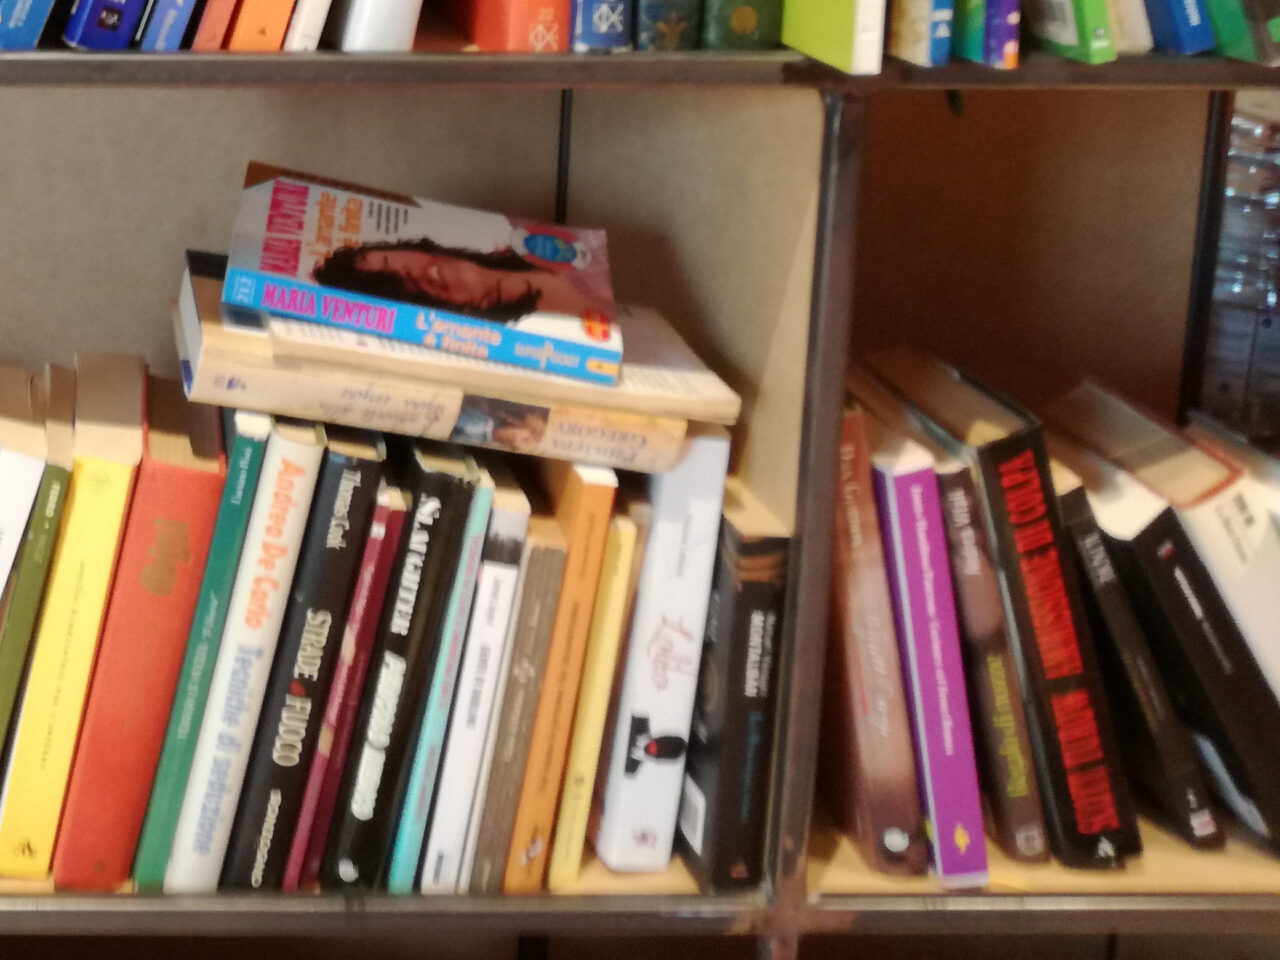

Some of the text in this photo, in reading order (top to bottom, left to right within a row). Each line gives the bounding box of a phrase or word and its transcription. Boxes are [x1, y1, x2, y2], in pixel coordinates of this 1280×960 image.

[259, 280, 398, 337] MARIA VENTURI
[414, 308, 504, 349] L'amante
[241, 457, 308, 632] Andrea De Carlo
[388, 492, 443, 636] SLAUGHTER
[216, 643, 266, 730] Tecniche
[270, 607, 333, 768] STRADE FUOCO
[214, 731, 244, 755] di
[188, 754, 240, 856] seduzione
